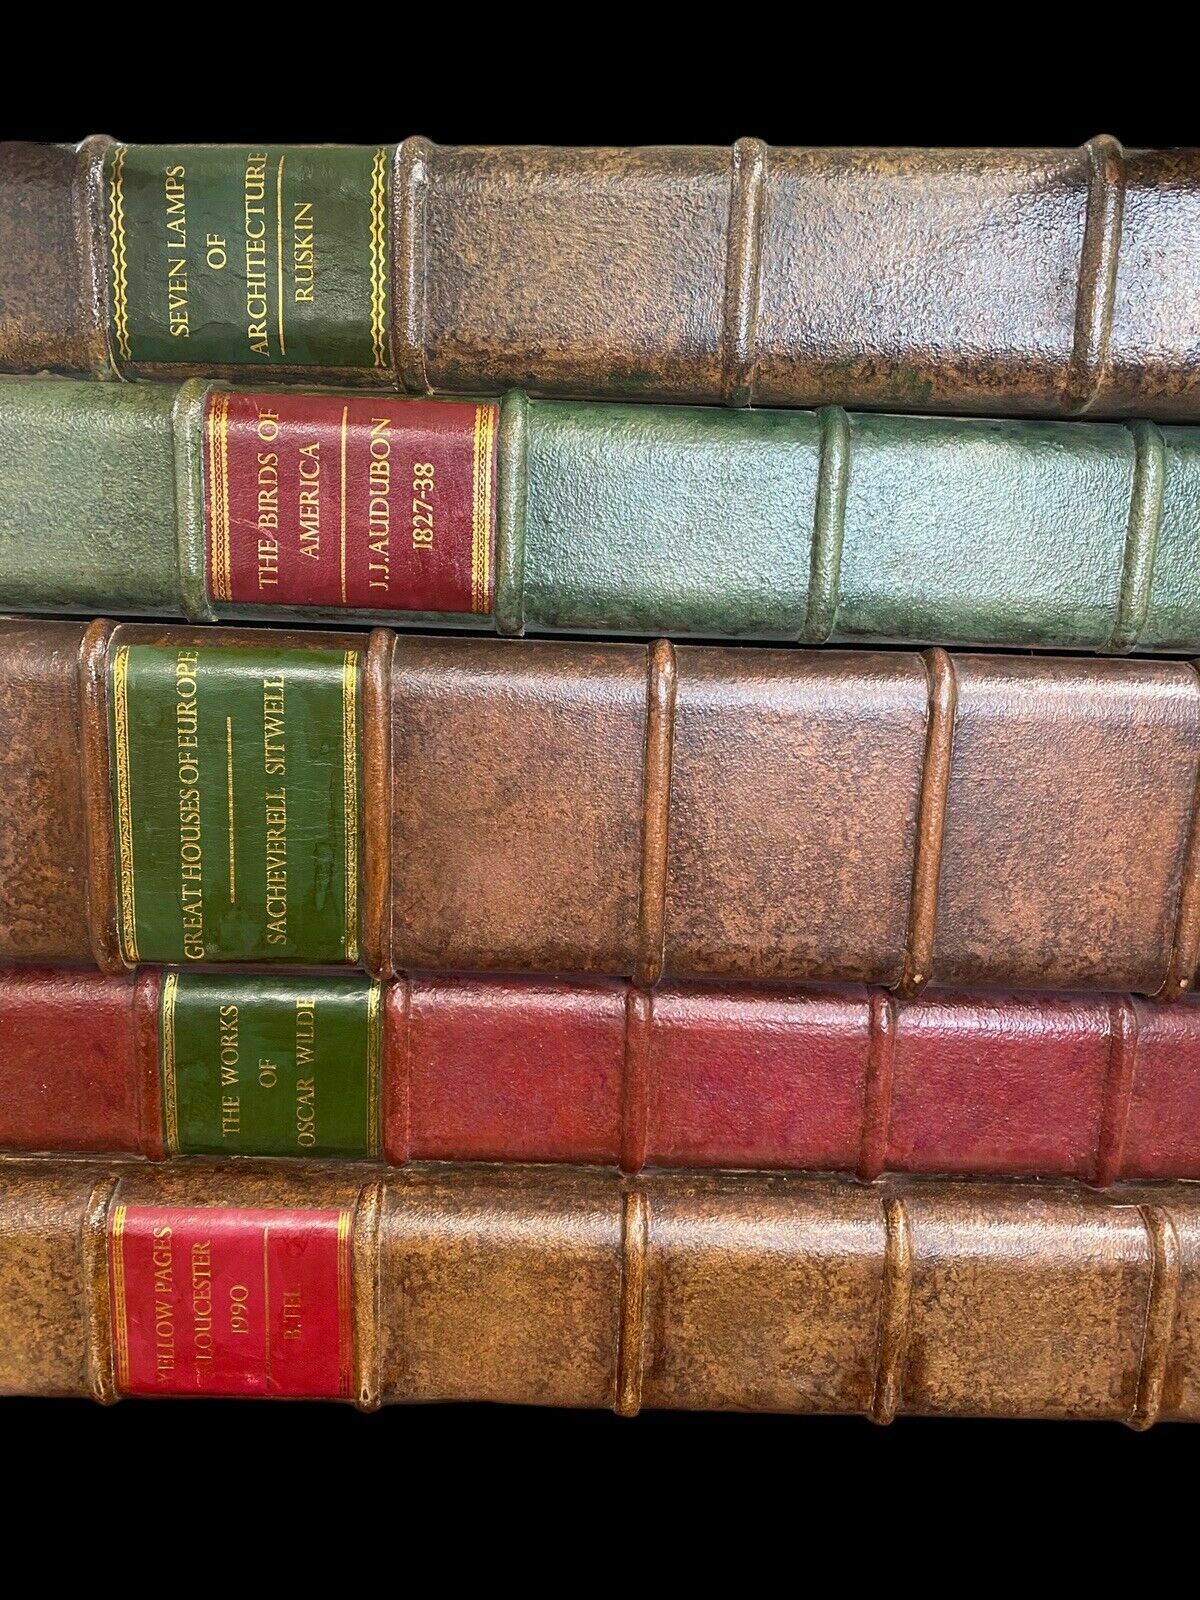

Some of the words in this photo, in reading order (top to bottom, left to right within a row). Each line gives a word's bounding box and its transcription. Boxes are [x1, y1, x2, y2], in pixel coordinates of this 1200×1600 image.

[165, 165, 187, 248] LAMPS
[206, 233, 227, 270] OF
[245, 152, 270, 357] ARCHITECTURE
[294, 202, 314, 302] RUSKIN
[168, 258, 190, 338] SEVEN
[258, 408, 280, 441] OF
[257, 452, 279, 528] BIRDS
[299, 442, 320, 560] AMERICA
[412, 462, 435, 550] 1827-38
[257, 539, 279, 590] THE
[176, 650, 200, 748] EUROPE
[264, 673, 286, 775] SITWELL
[179, 752, 199, 785] OF
[180, 788, 202, 881] HOUSES
[265, 787, 287, 945] SACHEVERELL
[181, 884, 205, 960] GREAT
[219, 1005, 239, 1086] WORKS
[296, 995, 316, 1065] WILDE
[258, 1058, 278, 1088] OF
[296, 1076, 316, 1148] OSCAR
[222, 1095, 240, 1137] THE
[152, 1226, 173, 1293] PAGES
[155, 1301, 175, 1384] YELLOW
[192, 1240, 213, 1376] LOUCESTER
[229, 1284, 248, 1334] 1990
